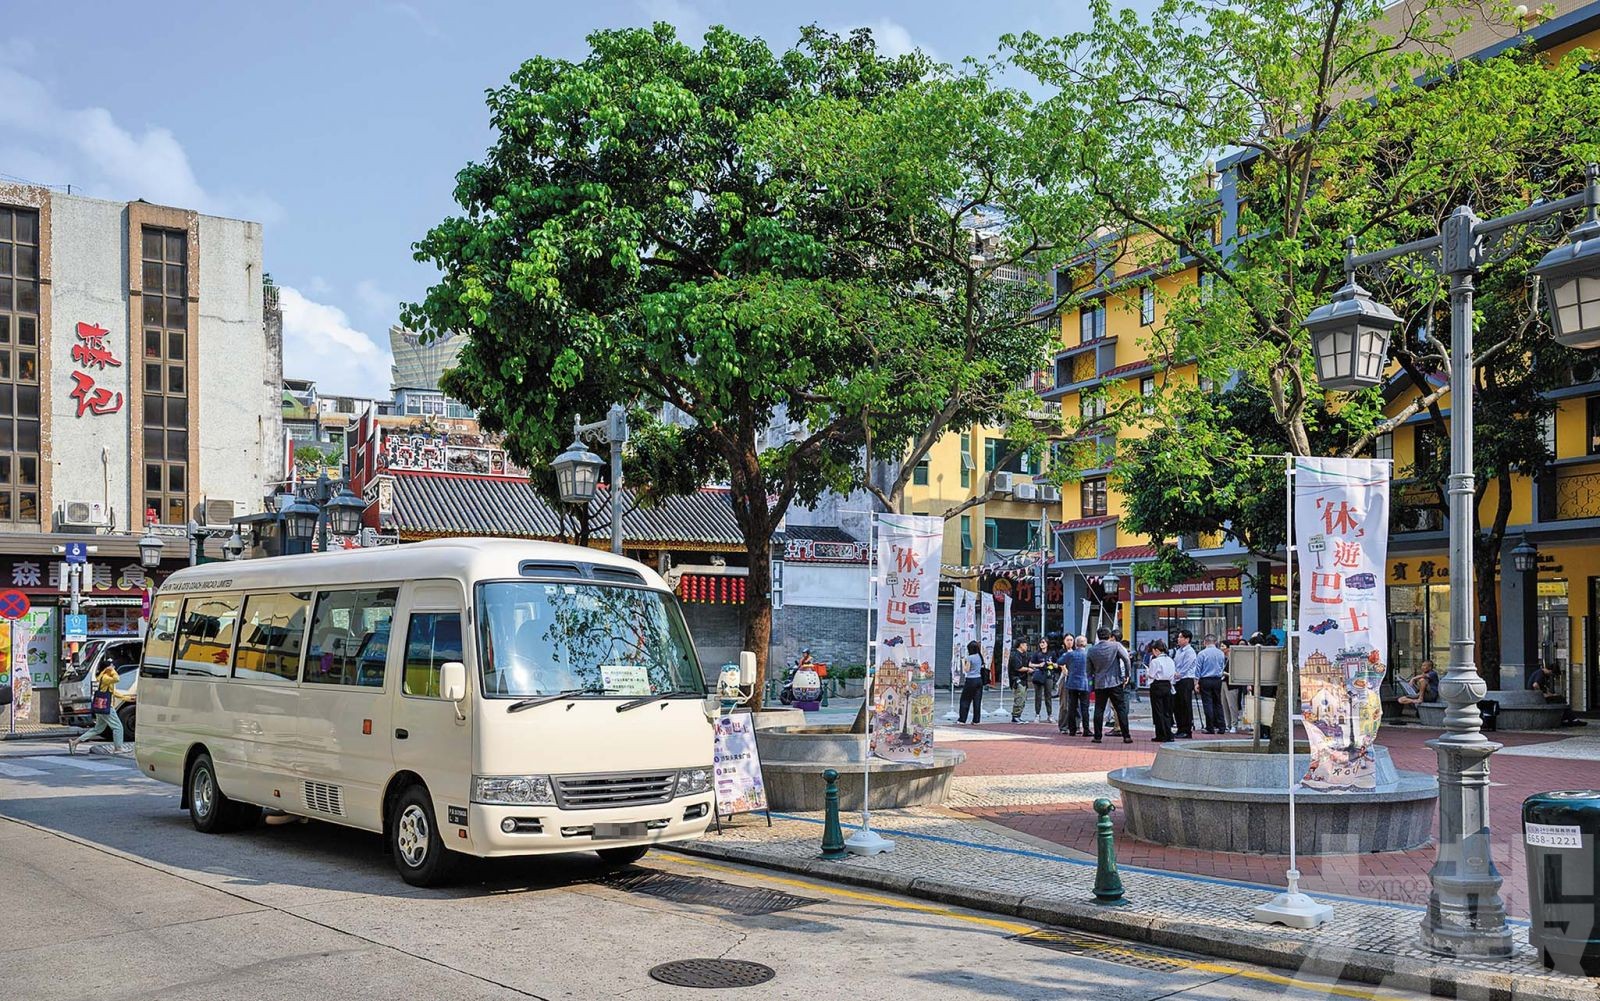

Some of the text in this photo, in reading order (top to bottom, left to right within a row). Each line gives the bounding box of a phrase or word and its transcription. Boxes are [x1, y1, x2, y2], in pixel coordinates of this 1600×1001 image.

[1170, 581, 1214, 595] supermarket
[30, 672, 52, 683] EA
[1527, 833, 1578, 846] 6658-1221
